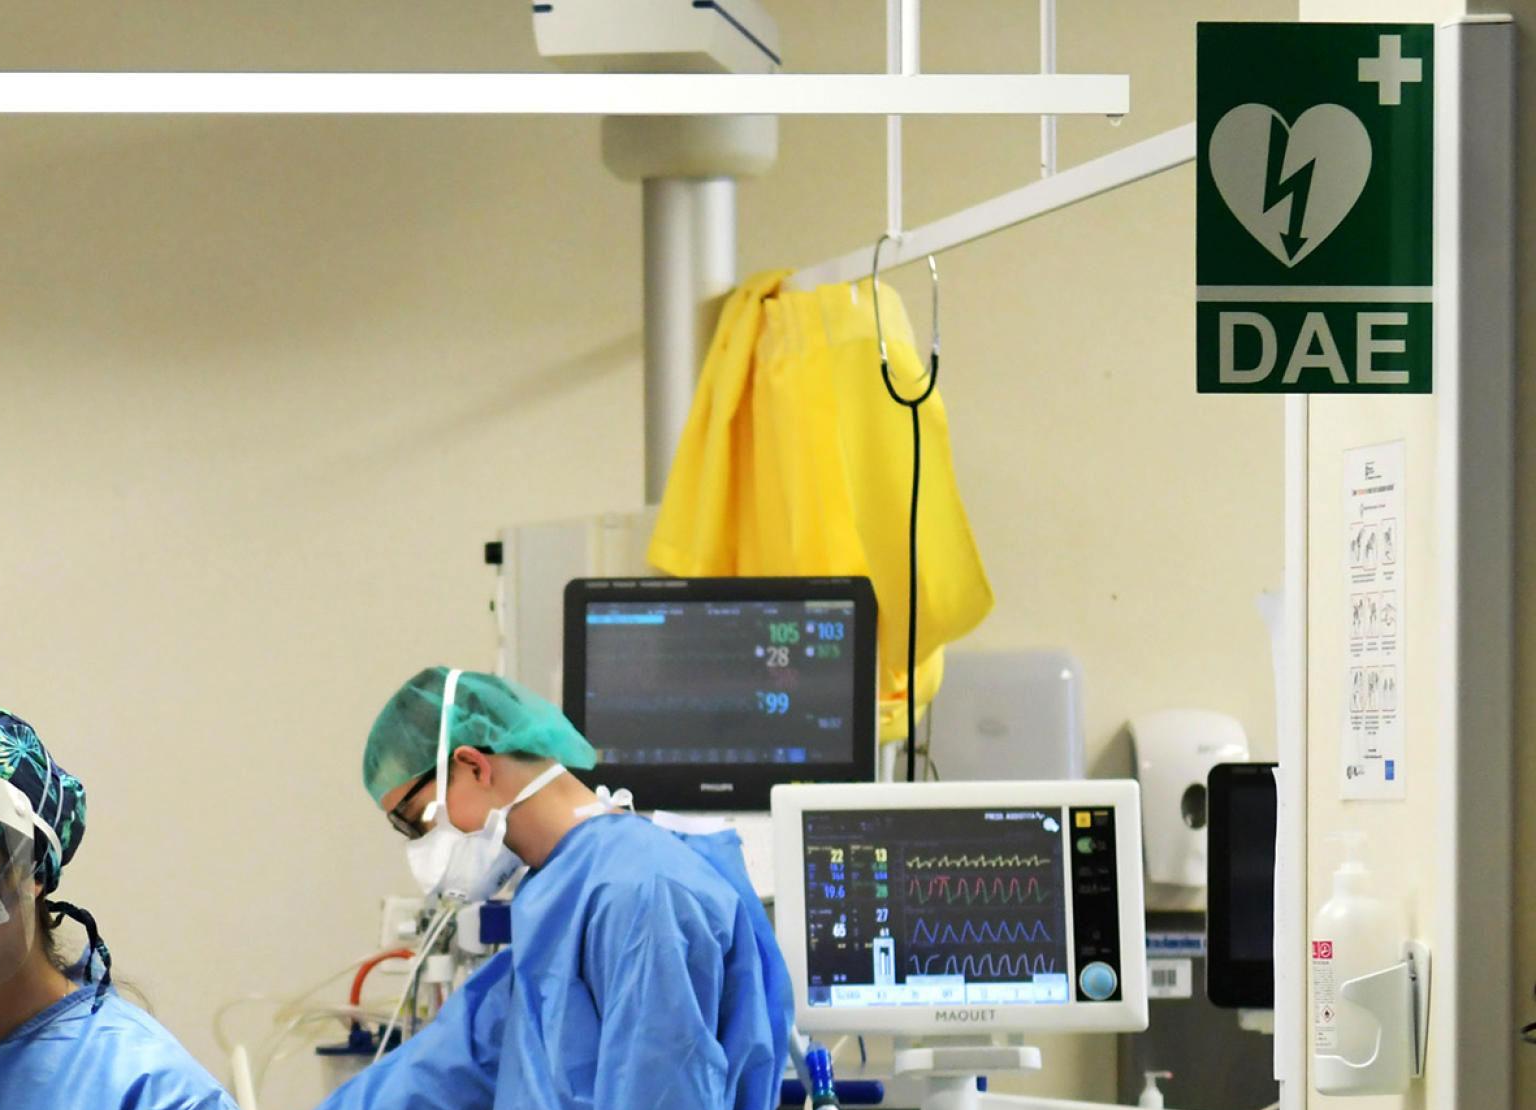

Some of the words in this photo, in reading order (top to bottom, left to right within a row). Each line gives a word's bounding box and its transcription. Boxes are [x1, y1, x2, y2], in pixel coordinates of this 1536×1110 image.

[1219, 311, 1410, 384] DAE
[770, 622, 800, 643] 105
[818, 622, 844, 641] 103
[766, 646, 789, 667] 28
[766, 692, 789, 714] 99
[876, 908, 888, 922] 27
[935, 1009, 996, 1023] MAQUET
